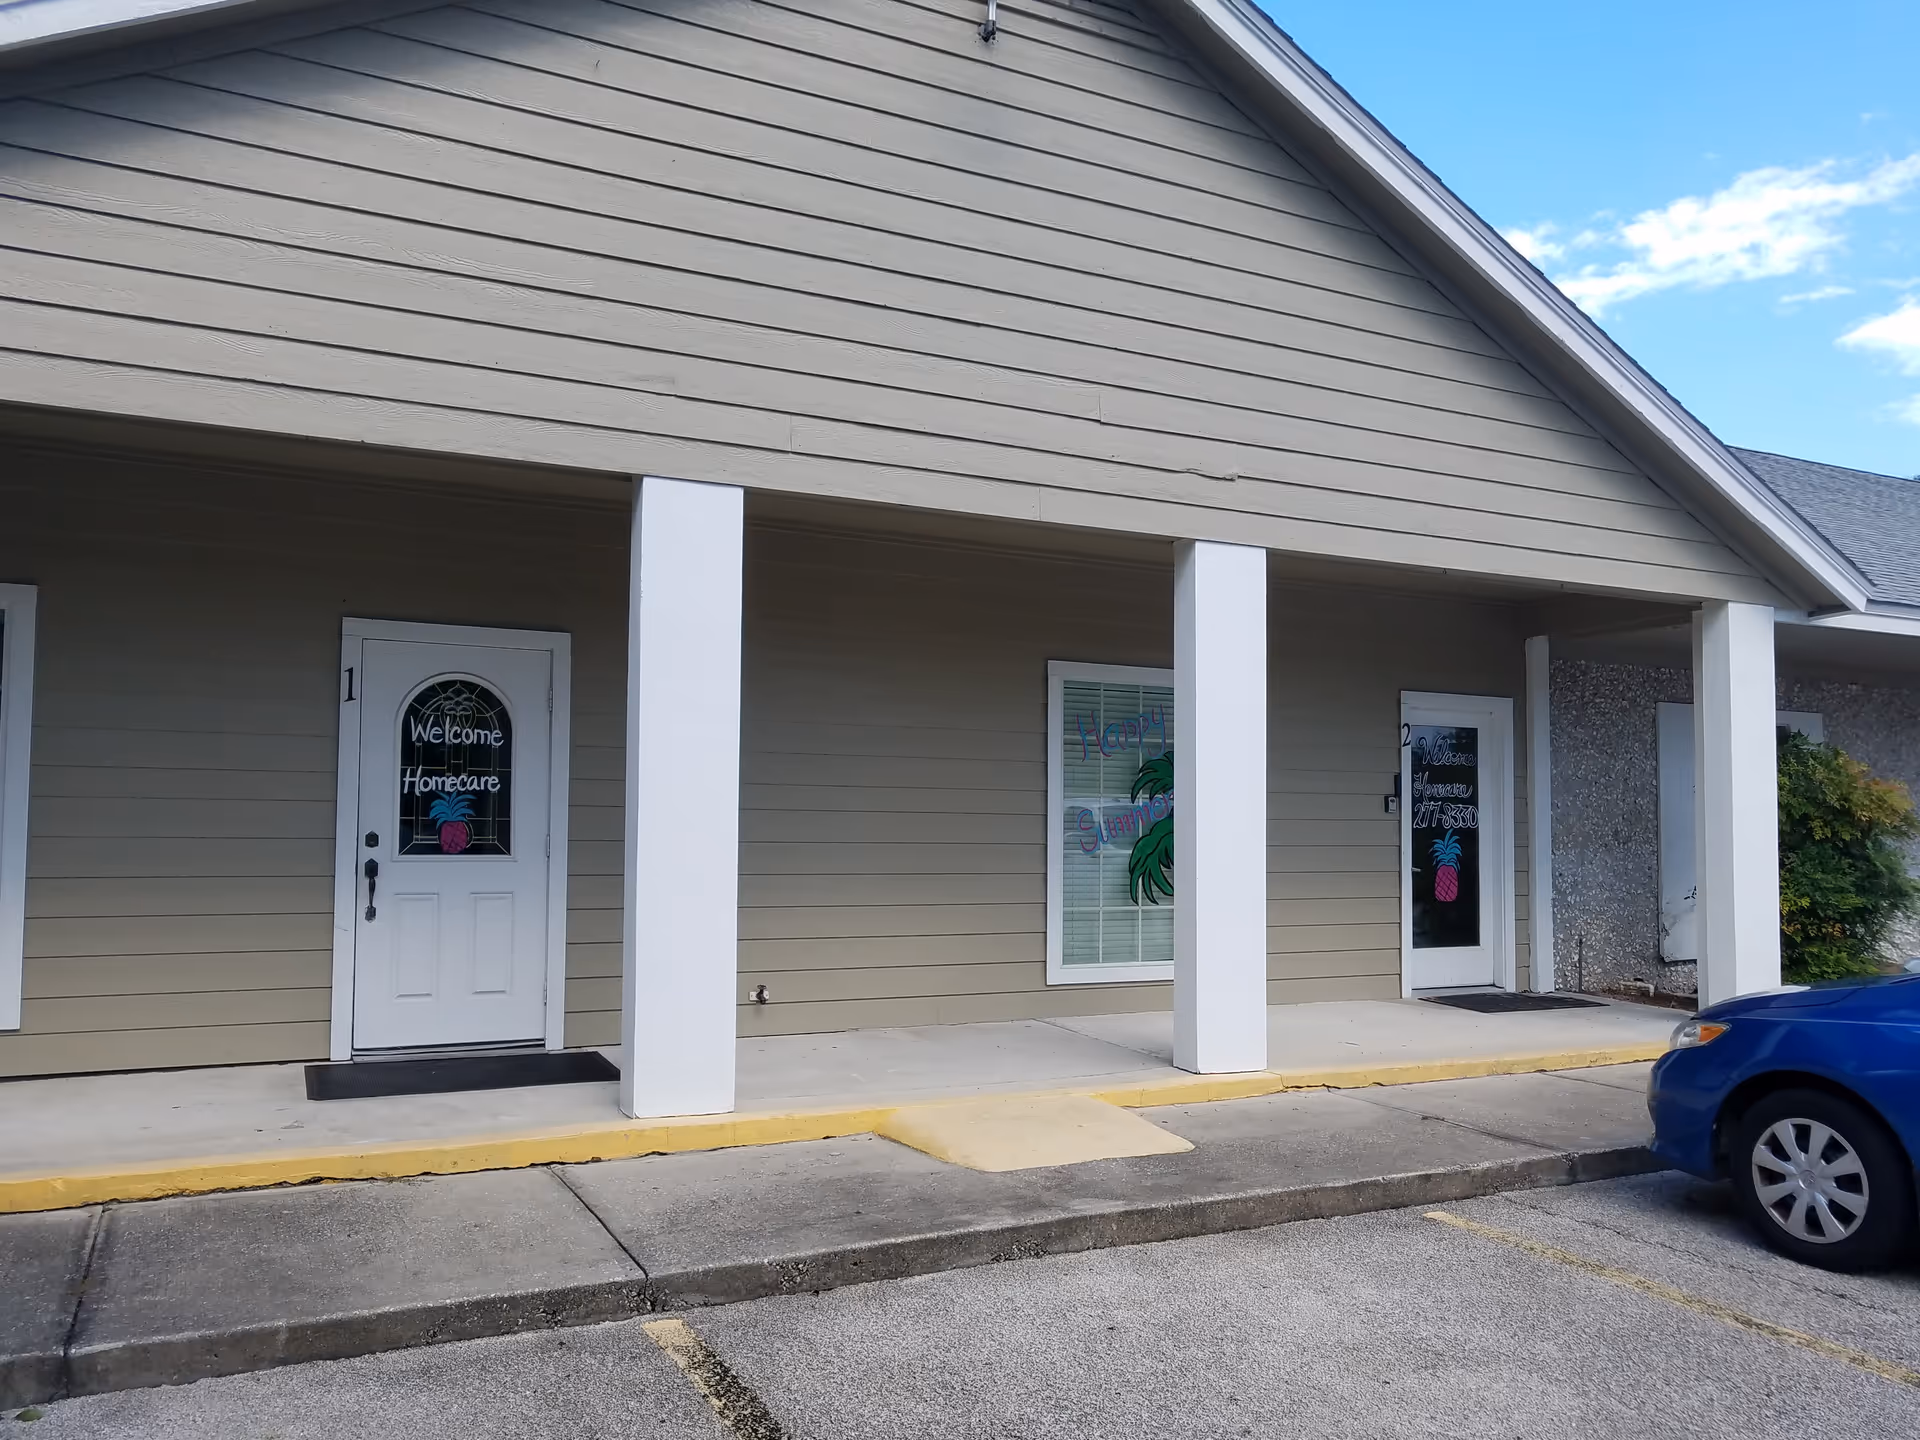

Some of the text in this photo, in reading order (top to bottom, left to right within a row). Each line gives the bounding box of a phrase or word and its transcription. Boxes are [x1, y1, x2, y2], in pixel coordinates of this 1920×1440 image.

[410, 715, 505, 746] Welcome
[1076, 703, 1166, 762] Happy
[1402, 722, 1412, 748] 2
[1417, 734, 1476, 766] Welcome
[403, 765, 501, 796] Homecare
[1413, 771, 1474, 803] Homecare
[1413, 801, 1479, 828] 277-8330
